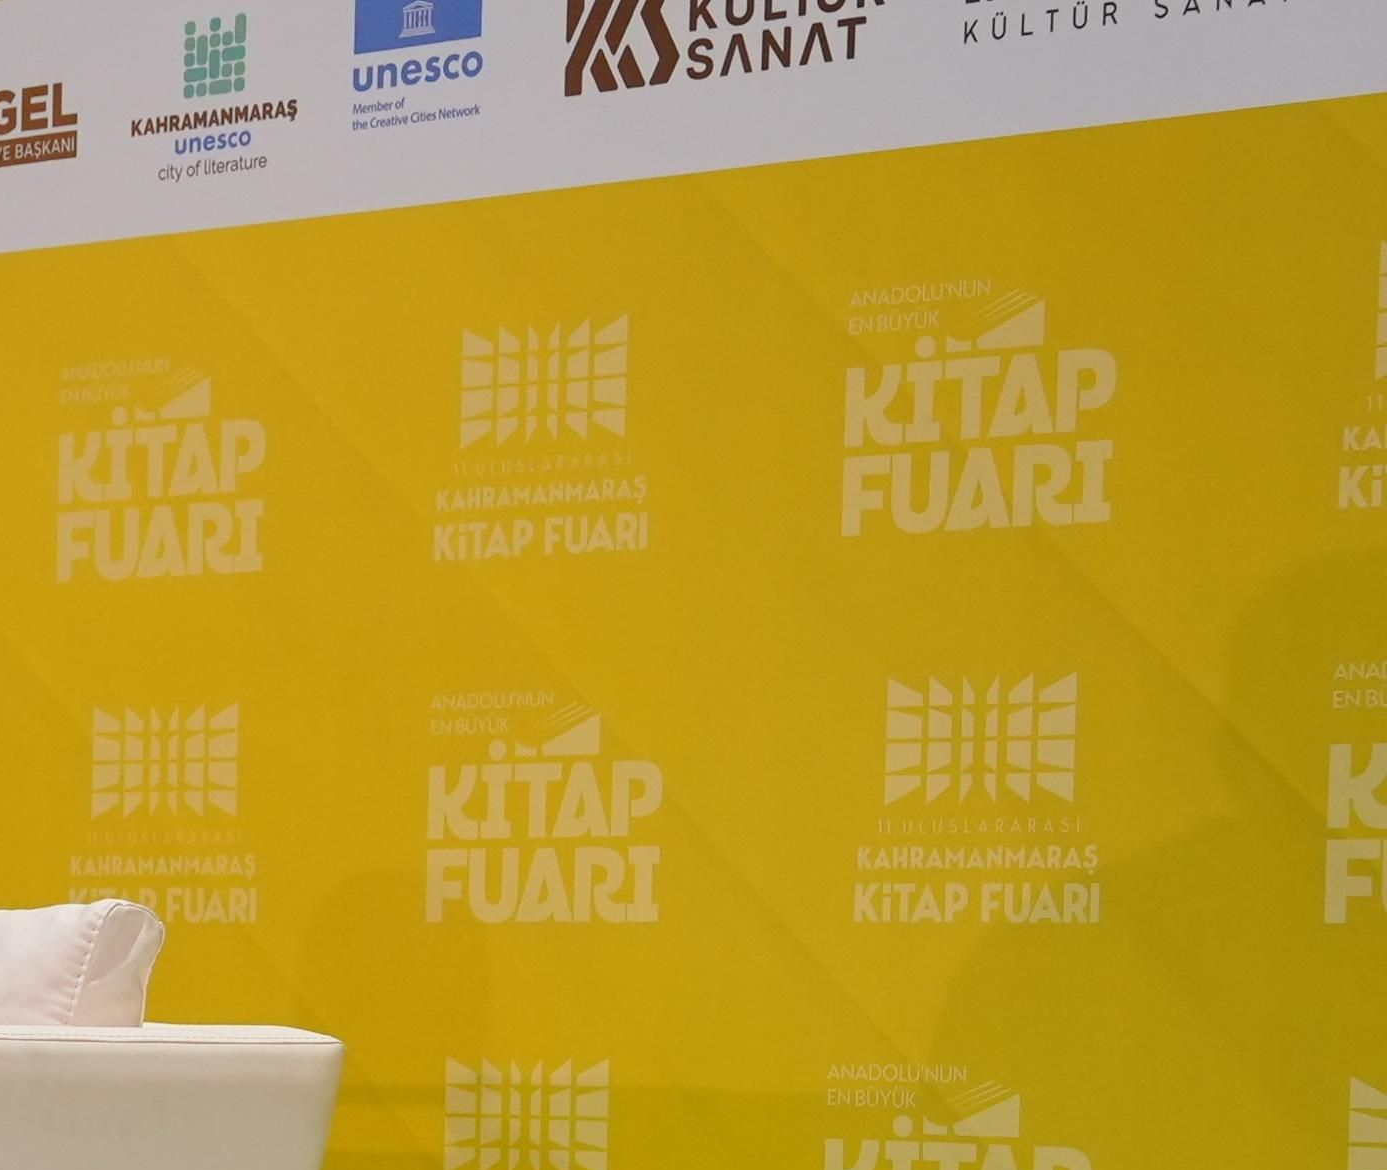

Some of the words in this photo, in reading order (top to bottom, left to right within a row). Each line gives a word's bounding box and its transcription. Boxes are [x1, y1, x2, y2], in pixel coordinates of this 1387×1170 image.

[964, 1, 1118, 45] KÜLTÜR
[686, 16, 867, 80] SANAT
[353, 51, 483, 92] unesco
[131, 98, 299, 138] KAHRAMANMARAŞ
[352, 101, 393, 115] Member
[394, 97, 406, 110] of
[352, 119, 368, 131] the
[370, 115, 408, 129] Creative
[410, 111, 437, 124] Cities
[438, 103, 481, 120] Network
[14, 135, 76, 159] BAŞKANI
[174, 130, 252, 155] unesco
[157, 163, 183, 183] city
[186, 159, 202, 178] of
[204, 155, 268, 176] literature
[848, 316, 874, 336] EN
[843, 335, 1118, 447] KİTAP
[435, 474, 648, 513] KAHRAMANMARAŞ
[841, 439, 1115, 538] FUARI
[56, 499, 264, 583] FUARI
[544, 511, 649, 556] FUARI
[856, 842, 1100, 876] KAHRAMANMARAŞ
[425, 846, 662, 924] FUARI
[980, 880, 1102, 926] FUARI
[165, 886, 258, 925] FUARI
[826, 1088, 851, 1107] EN
